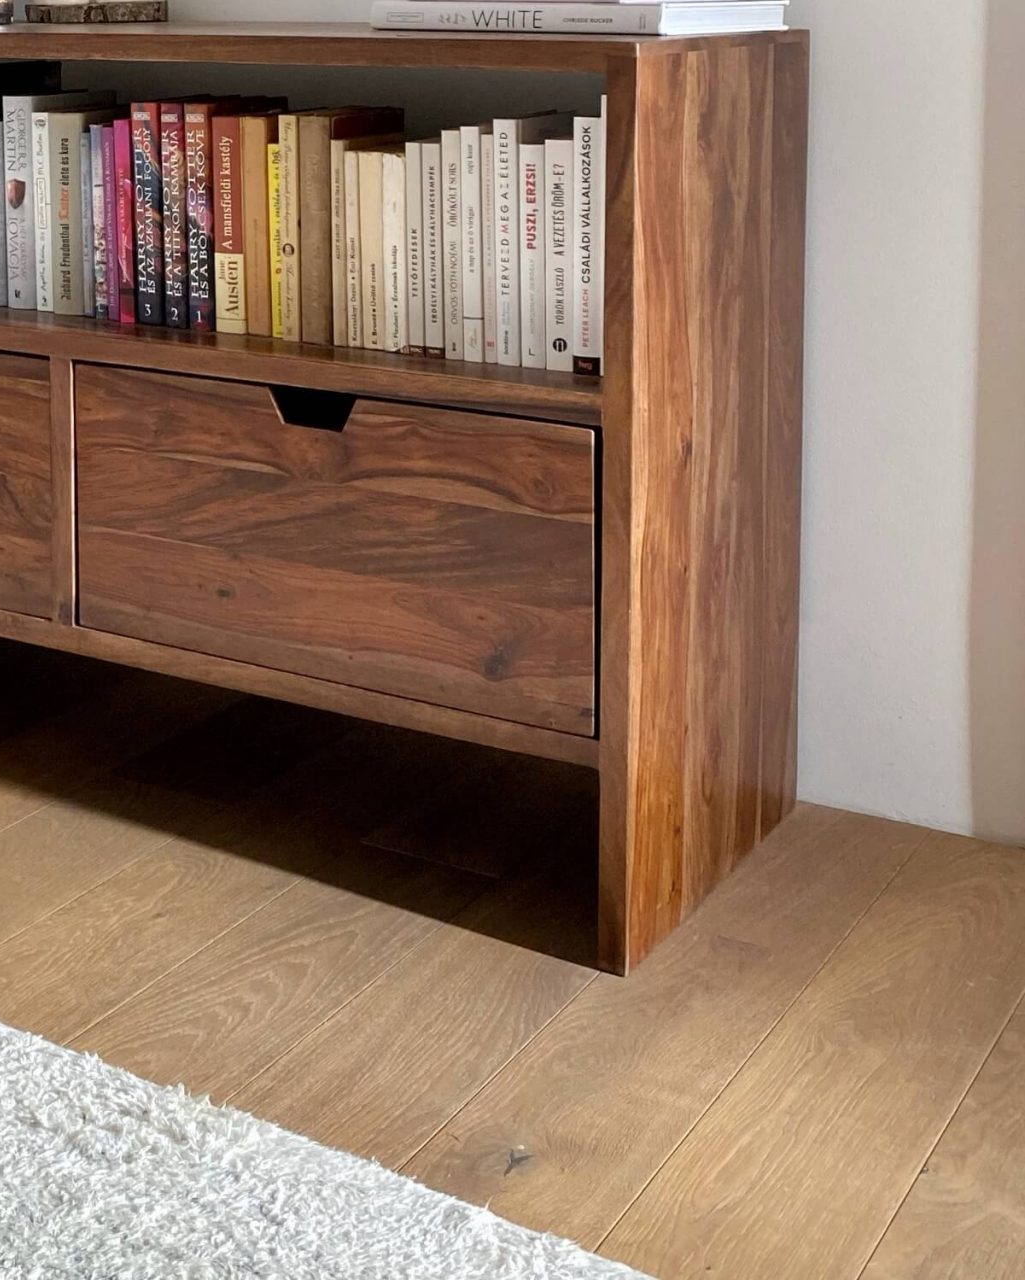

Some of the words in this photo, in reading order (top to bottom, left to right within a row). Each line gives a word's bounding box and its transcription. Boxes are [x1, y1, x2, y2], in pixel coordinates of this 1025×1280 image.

[471, 10, 545, 30] WHITE
[6, 109, 17, 171] MARTIN
[16, 108, 27, 149] GEORGE
[58, 137, 69, 155] kora
[59, 156, 69, 165] és
[143, 127, 152, 180] FOGOLY
[168, 130, 179, 196] KAMRÁJA
[193, 129, 206, 177] KÖVE
[219, 136, 232, 176] kastély
[465, 144, 473, 159] kaur
[497, 132, 509, 178] ÉLETED
[58, 168, 69, 186] élete
[133, 127, 144, 212] POTTER
[161, 129, 171, 215] POTTER
[186, 129, 197, 218] POTTER
[447, 163, 457, 186] SORS
[525, 163, 537, 204] ERZSI!
[578, 126, 592, 228] VÁLLALKOZÁSOK
[219, 178, 232, 237] mansfieldi
[426, 165, 436, 237] KÁLYHACSEMPÉK
[446, 186, 457, 227] ÖRÖKÖLT
[499, 183, 509, 200] AZ
[144, 187, 154, 252] AZKABANI
[171, 201, 181, 259] TITKOK
[195, 181, 207, 259] BÖLCSEK
[466, 206, 476, 229] virágai
[499, 205, 509, 234] MEG
[525, 208, 539, 250] PUSZI,
[551, 210, 565, 249] VEZETÉS
[8, 217, 20, 280] LOVAGJA
[59, 224, 71, 267] Friedenthal
[136, 220, 147, 293] HARRY
[222, 240, 232, 250] A
[427, 238, 436, 248] ÉS
[448, 241, 457, 270] NOÉMI
[467, 246, 474, 255] és
[468, 237, 474, 245] az
[578, 232, 592, 284] CSALÁDI
[146, 257, 154, 275] AZ
[163, 221, 173, 296] HARRY
[173, 265, 182, 276] A
[188, 227, 199, 297] HARRY
[198, 264, 208, 277] A
[218, 259, 227, 281] Jane
[409, 227, 418, 298] TETŐFEDÉSEK
[427, 249, 437, 290] KÁLYHÁK
[469, 255, 477, 268] nap
[500, 238, 510, 296] TERVEZD
[59, 270, 71, 300] Richard
[145, 279, 155, 294] ÉS
[172, 281, 182, 297] ÉS
[197, 281, 209, 299] ÉS
[225, 261, 239, 316] Austen
[553, 267, 564, 297] LÁSZLÓ
[144, 303, 152, 317] 3
[170, 307, 179, 321] 2
[196, 310, 202, 323] 1
[428, 290, 438, 324] ERDÉLYI
[554, 298, 565, 325] TÖRÖK
[581, 289, 590, 318] LEACH
[581, 320, 590, 348] PETER
